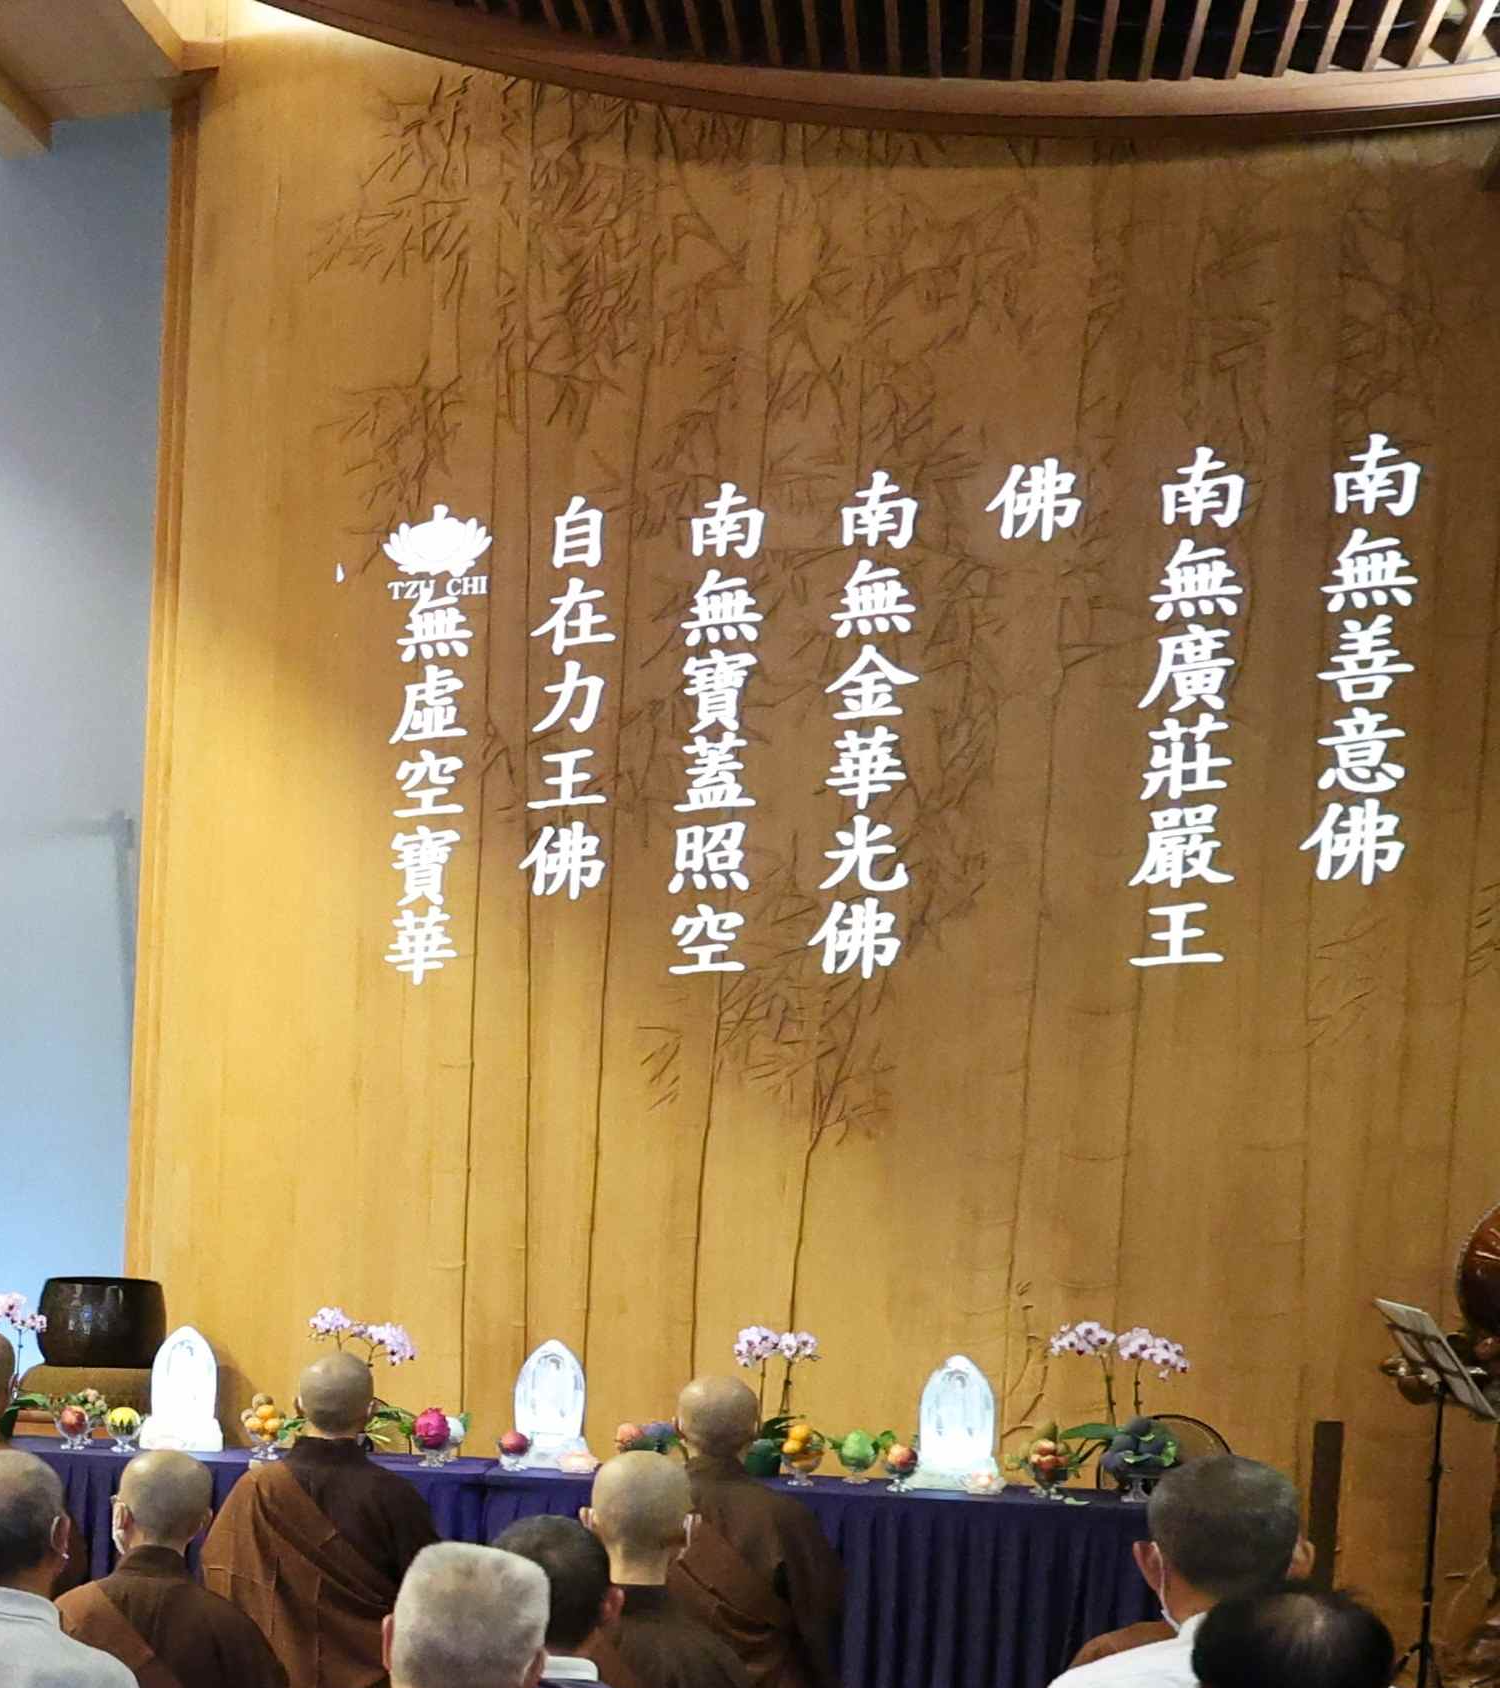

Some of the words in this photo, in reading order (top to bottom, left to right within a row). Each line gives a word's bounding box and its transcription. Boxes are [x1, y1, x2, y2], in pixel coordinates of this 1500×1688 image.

[387, 580, 436, 600] TZU
[446, 576, 488, 595] CHI
[518, 495, 617, 901] 自在力王佛
[667, 482, 766, 976] 南無寶蓋照空
[807, 470, 920, 980] 南無金華光佛
[984, 457, 1082, 542] 佛
[1129, 445, 1245, 967] 南無廣莊嚴王
[1299, 433, 1422, 886] 南無善意佛
[384, 504, 474, 986] 無虛空寶華
